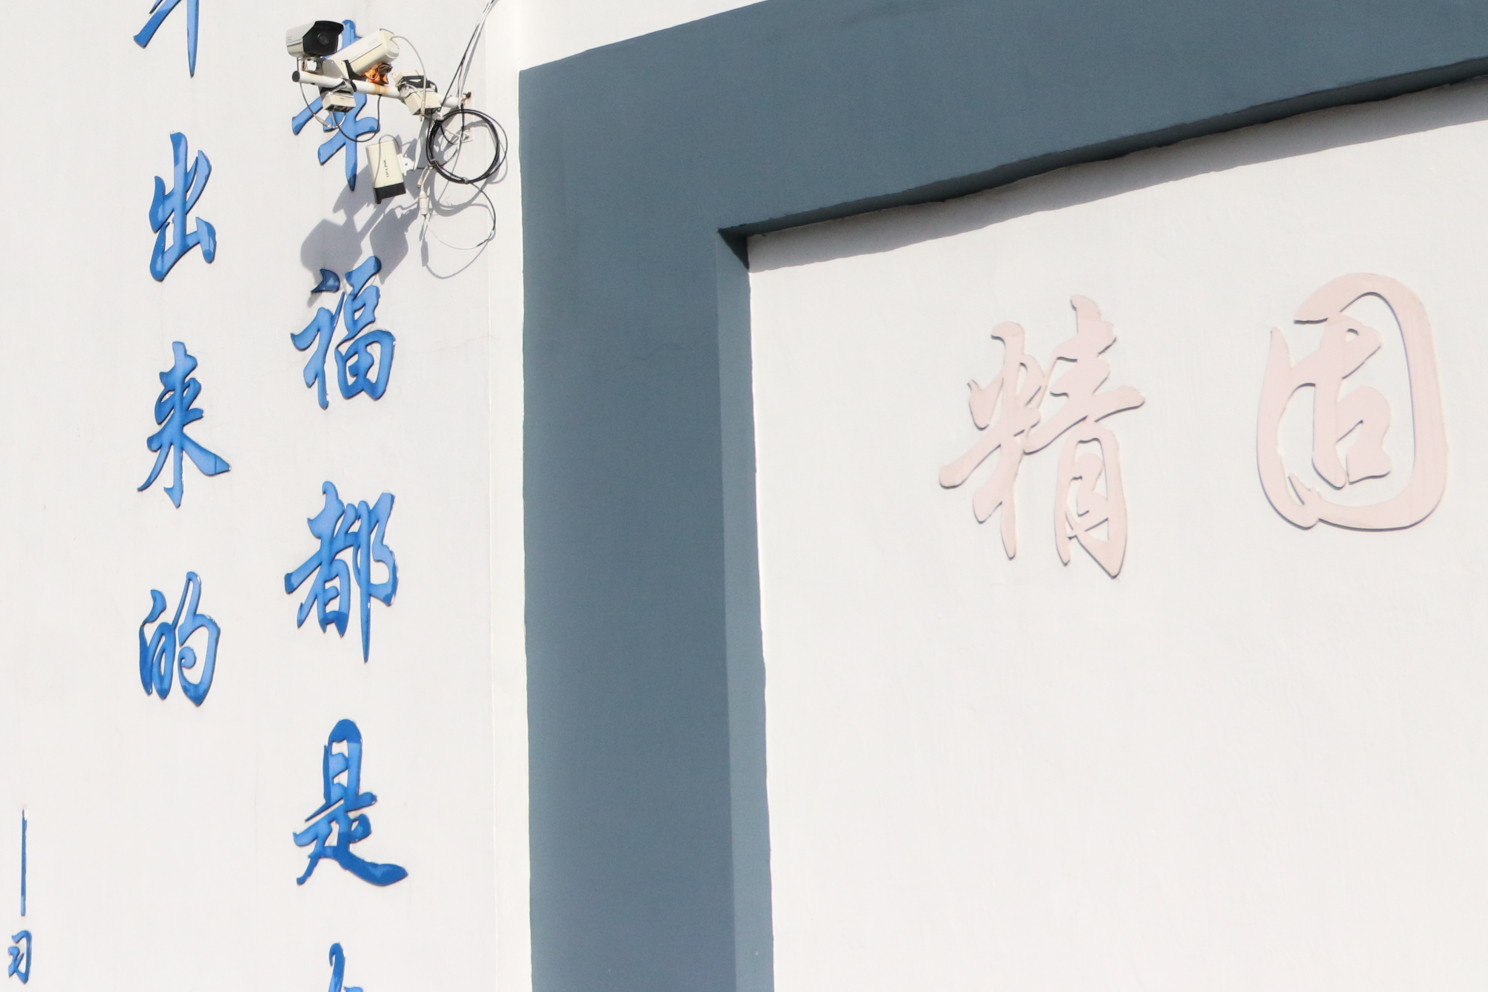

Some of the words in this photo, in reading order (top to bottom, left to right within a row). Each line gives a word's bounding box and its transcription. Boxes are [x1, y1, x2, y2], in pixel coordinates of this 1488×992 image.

[284, 18, 409, 992] 幸福都是
[938, 272, 1449, 579] 精固
